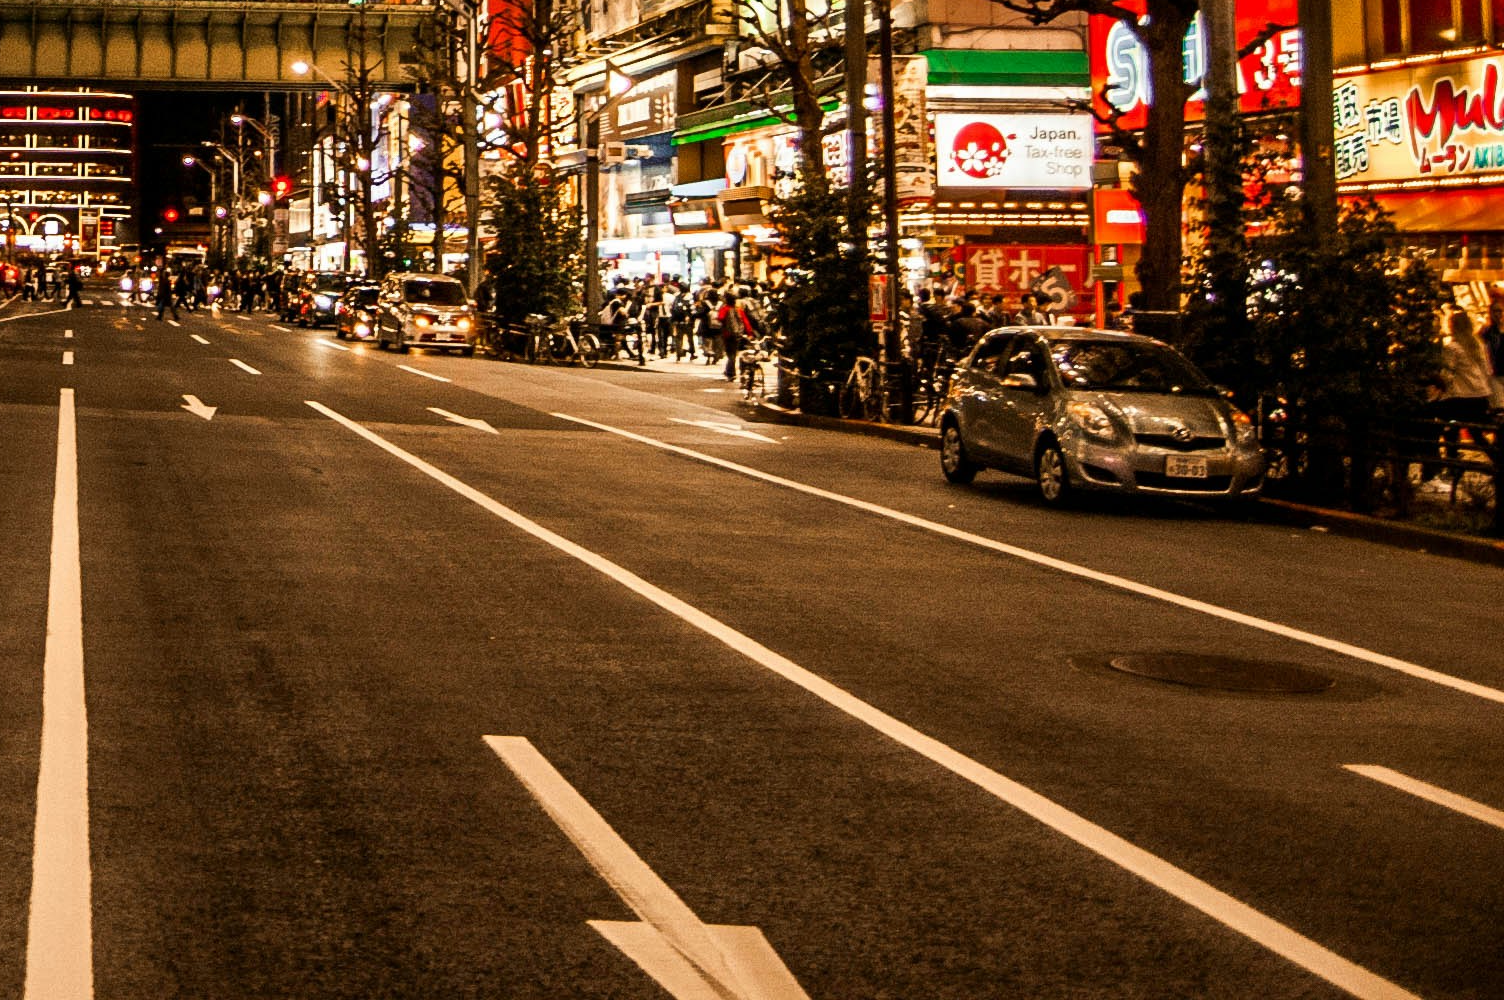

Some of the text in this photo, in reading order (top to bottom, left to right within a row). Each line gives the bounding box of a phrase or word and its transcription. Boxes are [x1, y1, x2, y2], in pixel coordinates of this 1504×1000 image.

[1405, 63, 1504, 161] Mul
[1024, 145, 1083, 161] Tax-free
[1046, 161, 1083, 180] Shop
